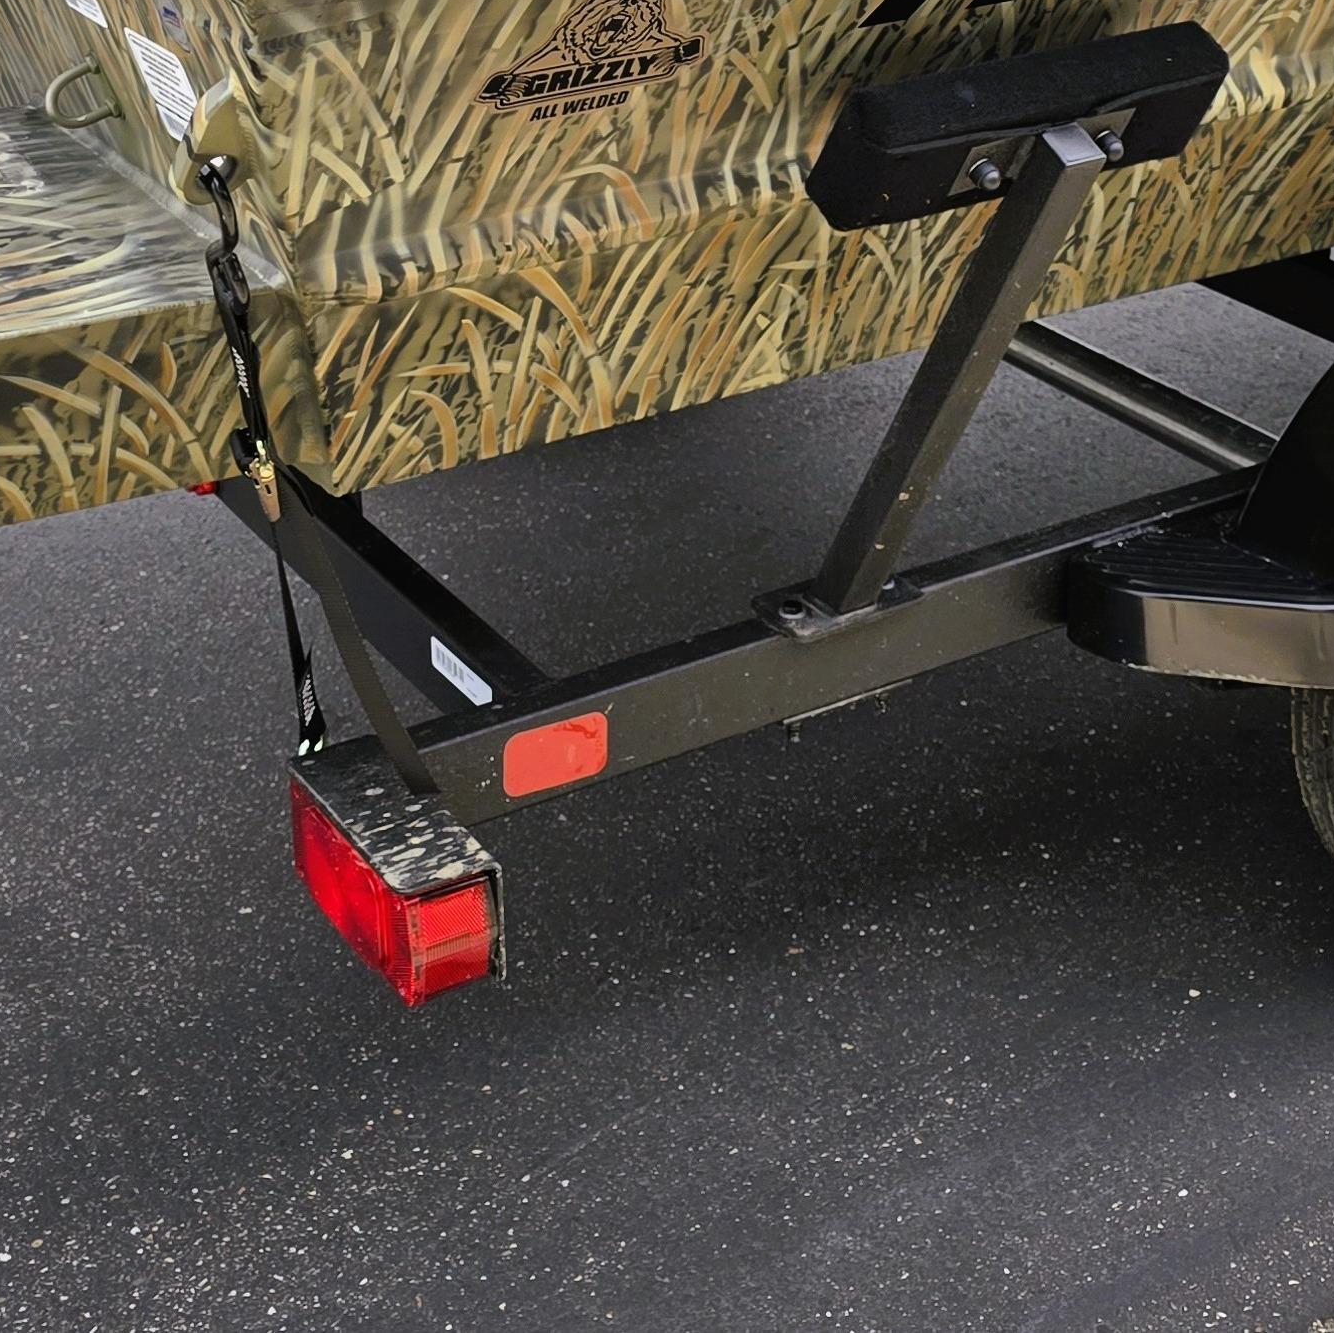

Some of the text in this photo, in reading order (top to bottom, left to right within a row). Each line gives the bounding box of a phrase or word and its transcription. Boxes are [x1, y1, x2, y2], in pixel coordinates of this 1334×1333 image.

[520, 54, 660, 97] GRIZZLY
[529, 90, 630, 122] ALL WELDED
